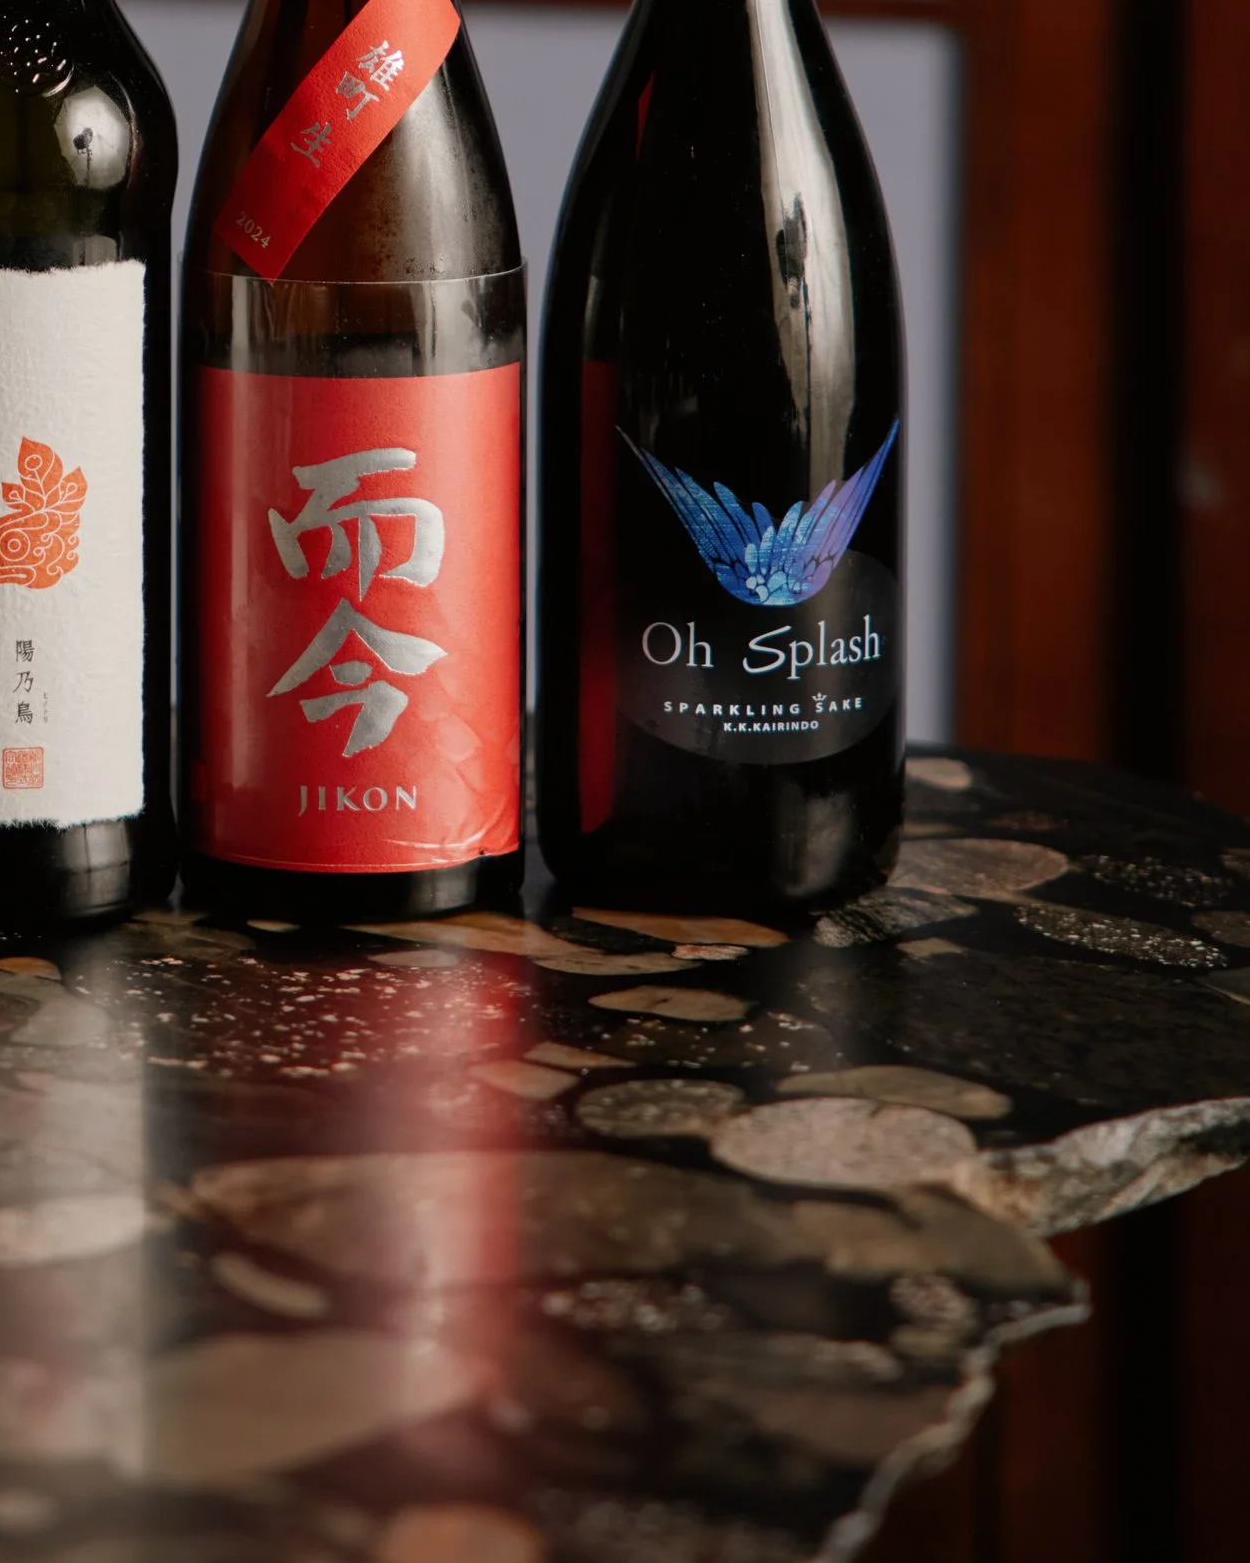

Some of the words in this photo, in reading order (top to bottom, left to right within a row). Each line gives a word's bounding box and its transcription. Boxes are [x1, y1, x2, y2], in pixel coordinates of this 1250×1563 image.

[291, 122, 332, 168] 生
[236, 211, 271, 249] 2024
[267, 447, 448, 757] 而今
[642, 621, 714, 667] Oh
[743, 614, 881, 679] Splash
[13, 639, 34, 724] 陽乃鳥
[664, 701, 800, 716] SPARKLING
[815, 697, 863, 714] SAKE
[723, 720, 819, 733] K.K.KAIRINDO
[297, 785, 417, 816] JIKON
